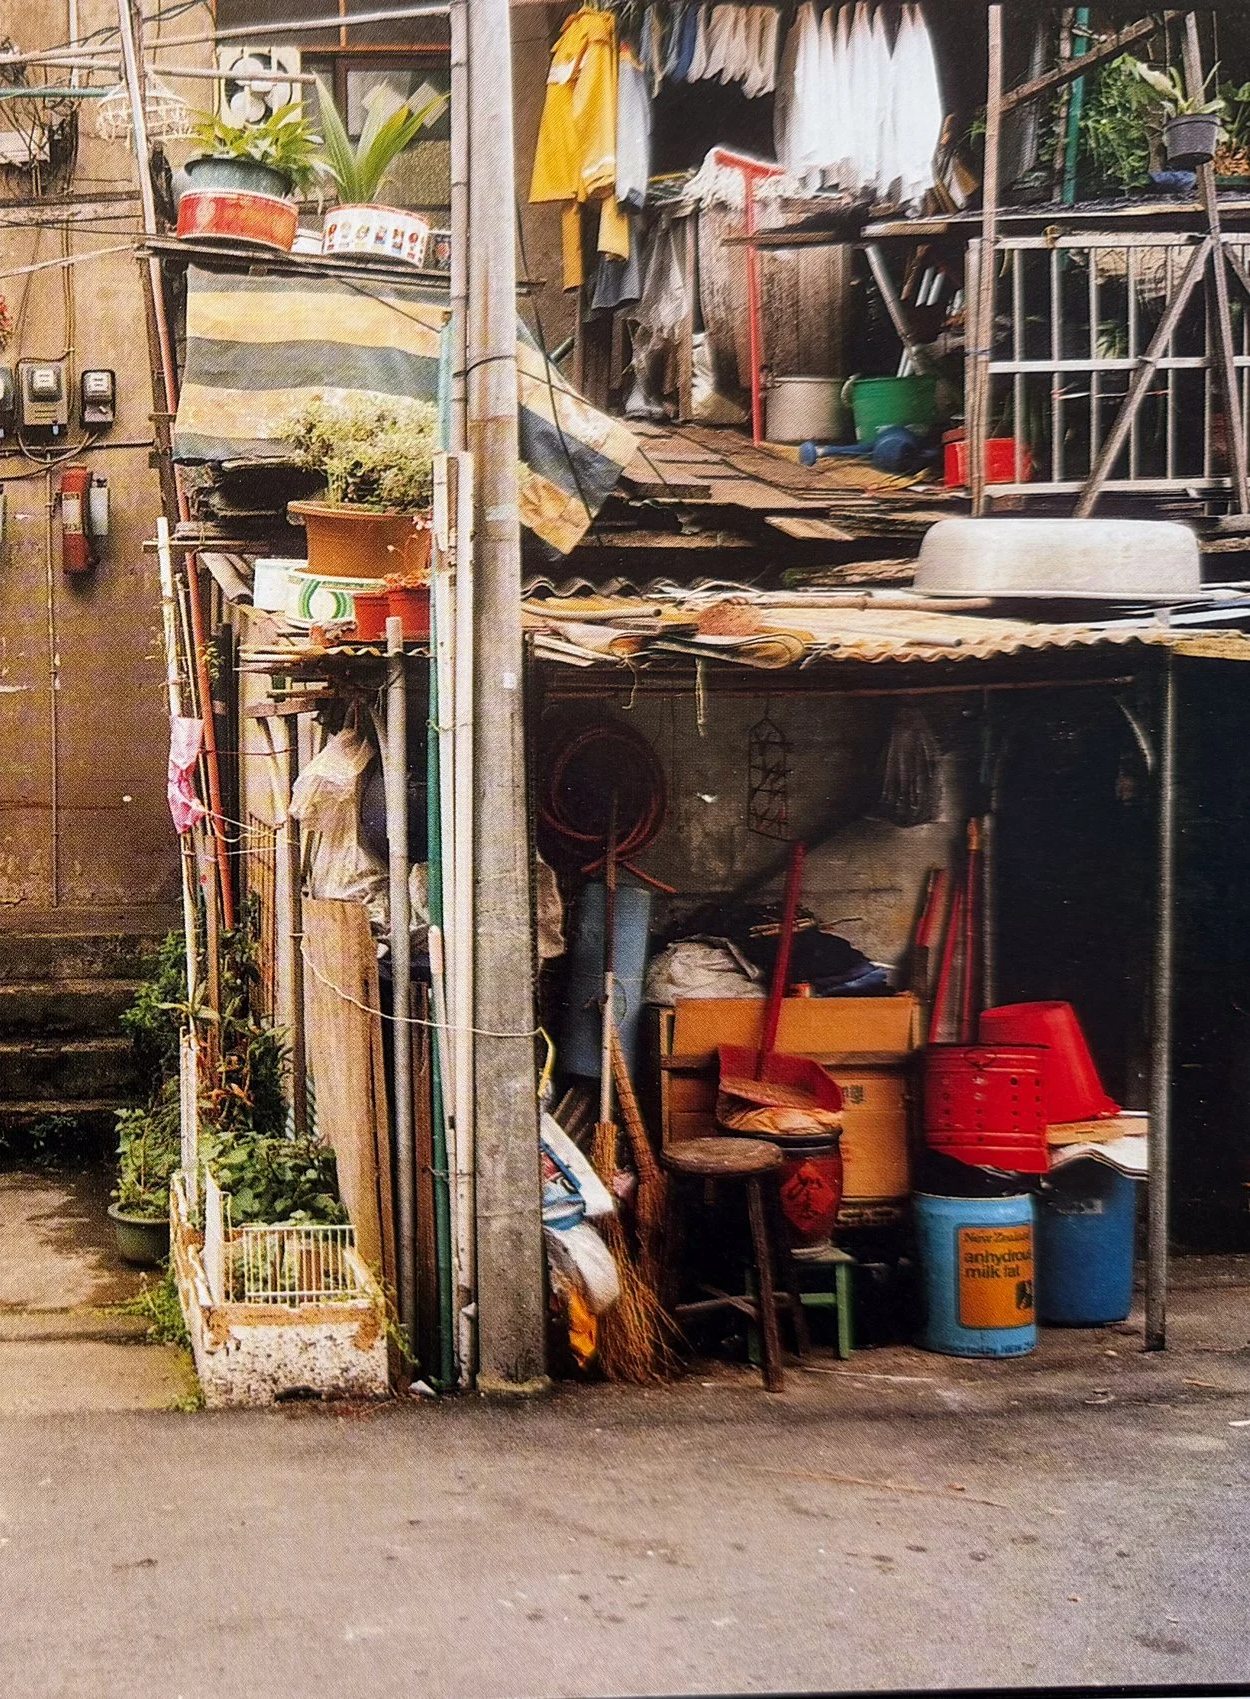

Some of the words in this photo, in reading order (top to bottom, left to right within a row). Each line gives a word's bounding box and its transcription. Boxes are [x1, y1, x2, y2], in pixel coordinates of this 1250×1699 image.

[964, 1231, 992, 1244] New
[965, 1264, 1001, 1279] milk
[1003, 1264, 1020, 1278] fat
